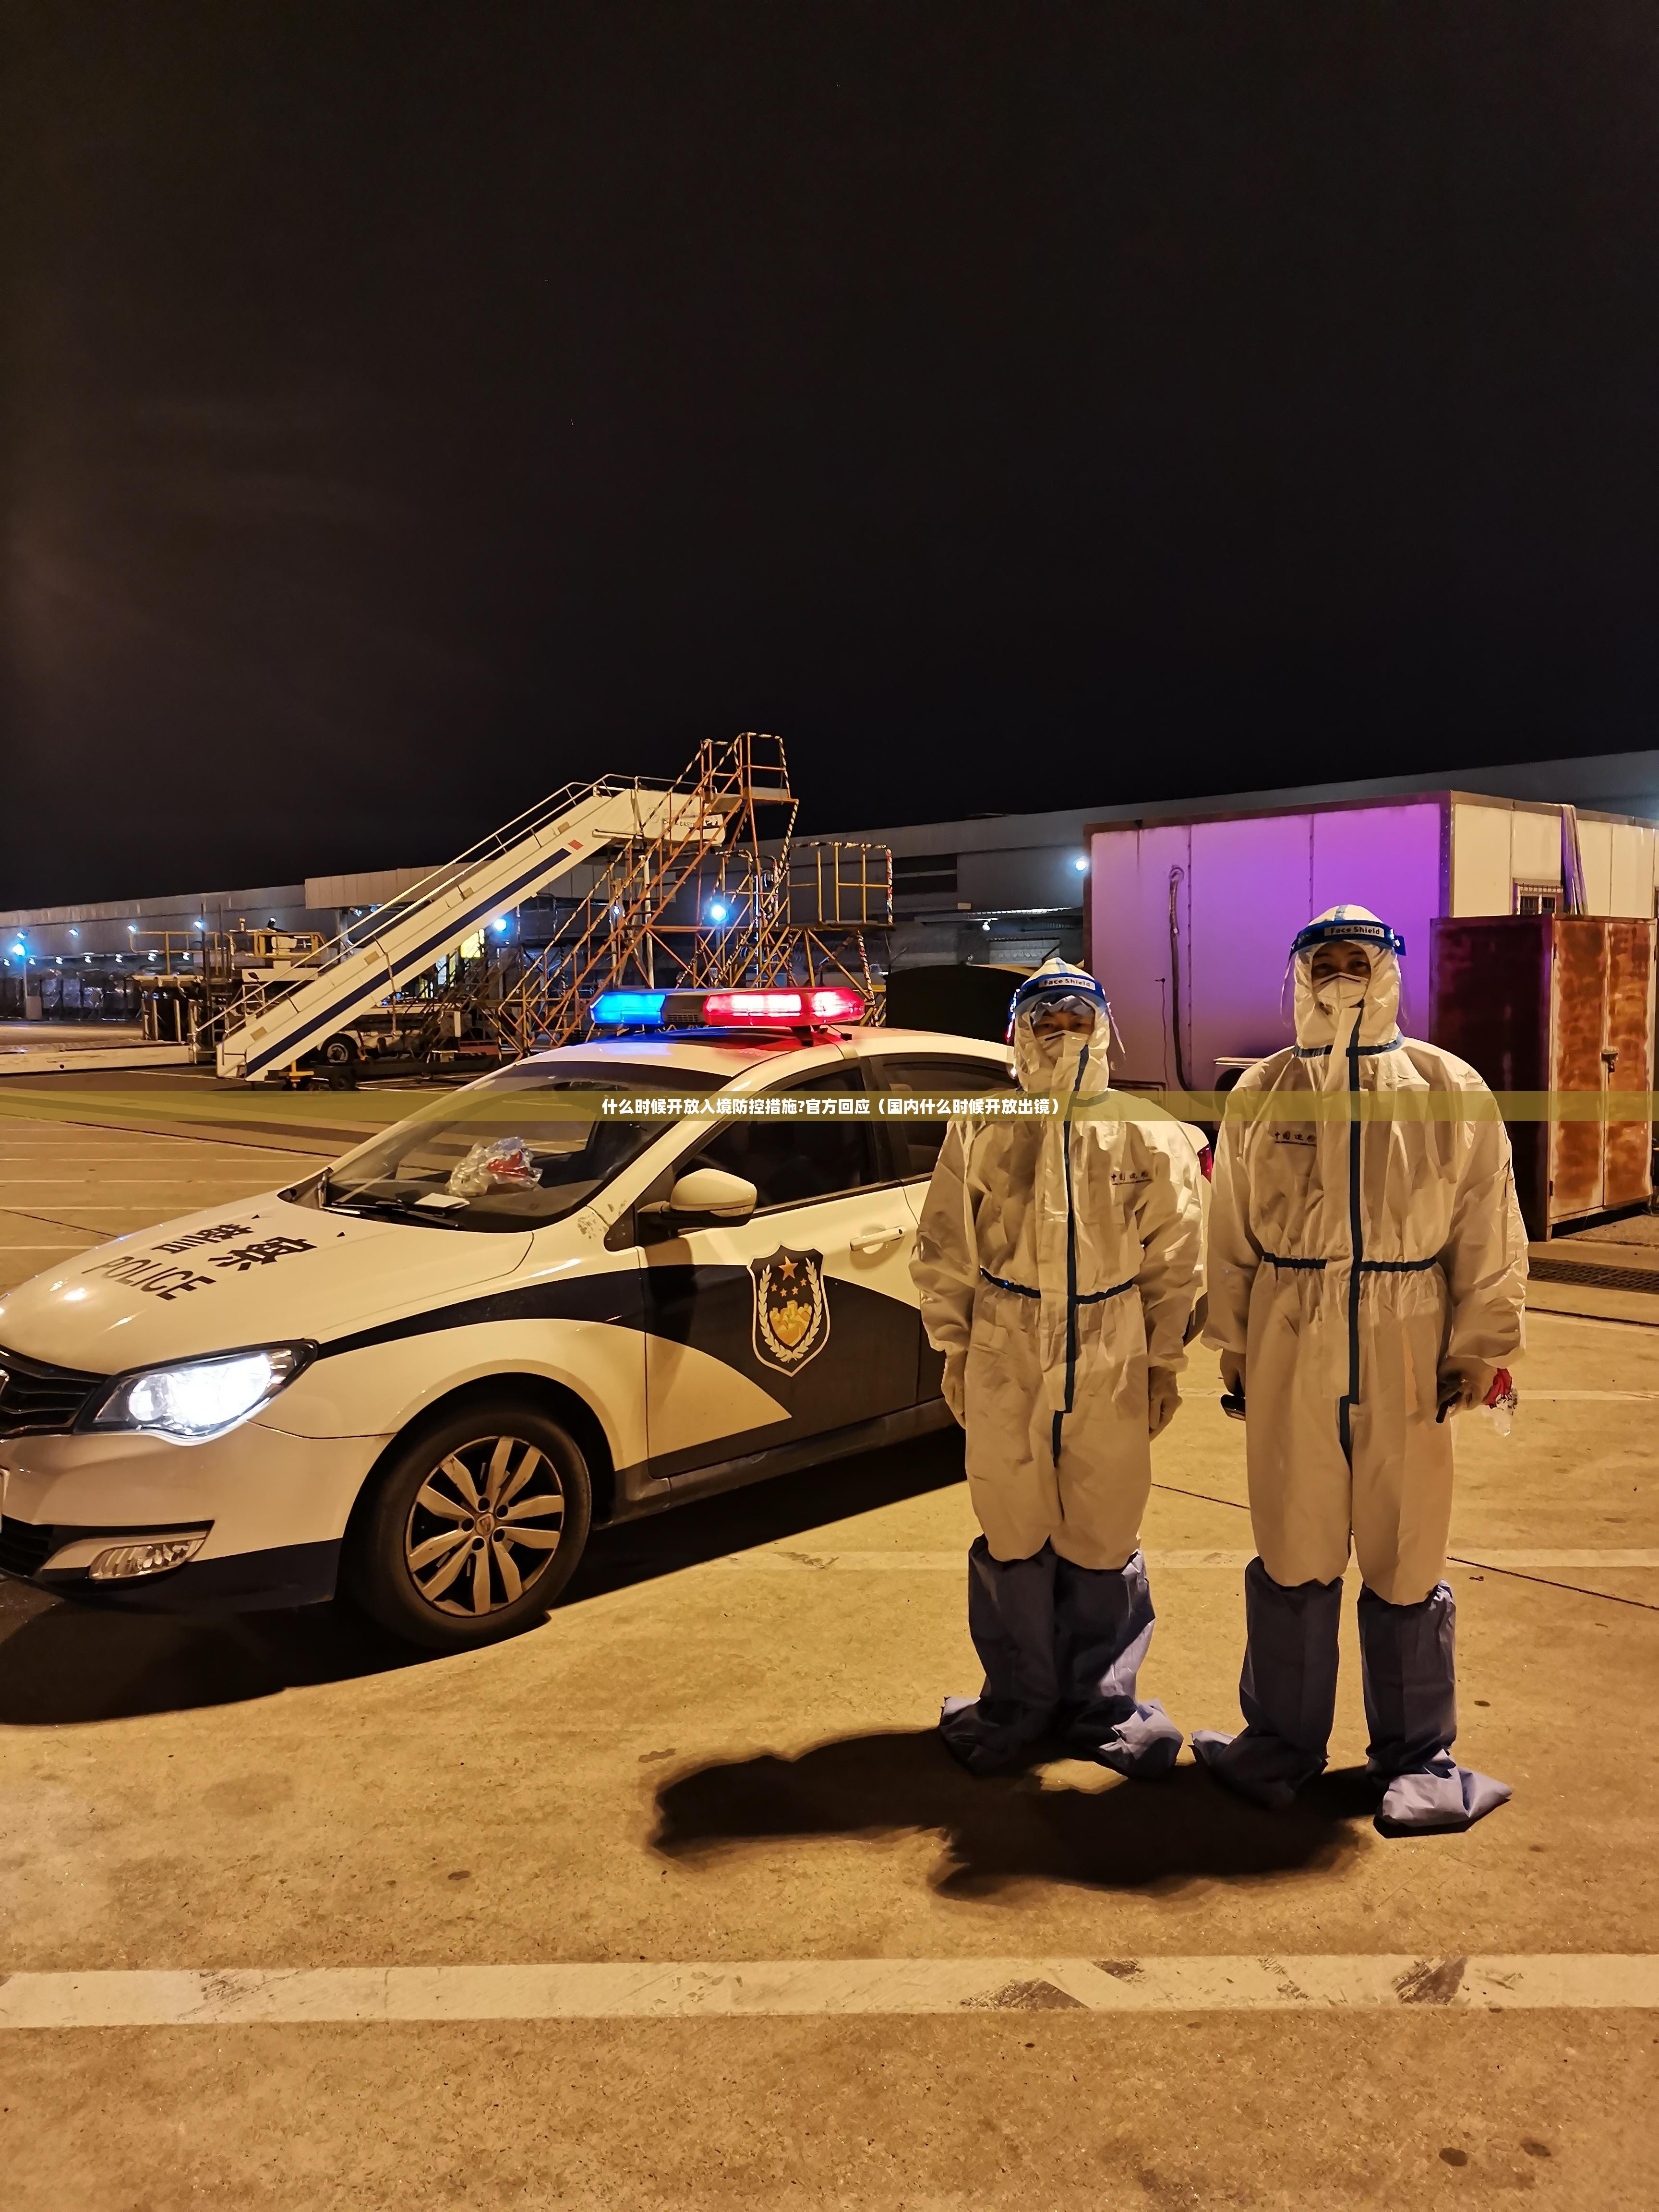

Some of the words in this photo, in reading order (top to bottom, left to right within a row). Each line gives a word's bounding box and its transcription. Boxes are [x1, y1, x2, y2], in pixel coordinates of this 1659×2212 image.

[1354, 926, 1380, 935] Shield
[1065, 978, 1090, 987] Shield
[151, 1224, 318, 1271] 警察
[81, 1256, 216, 1300] POLICE
